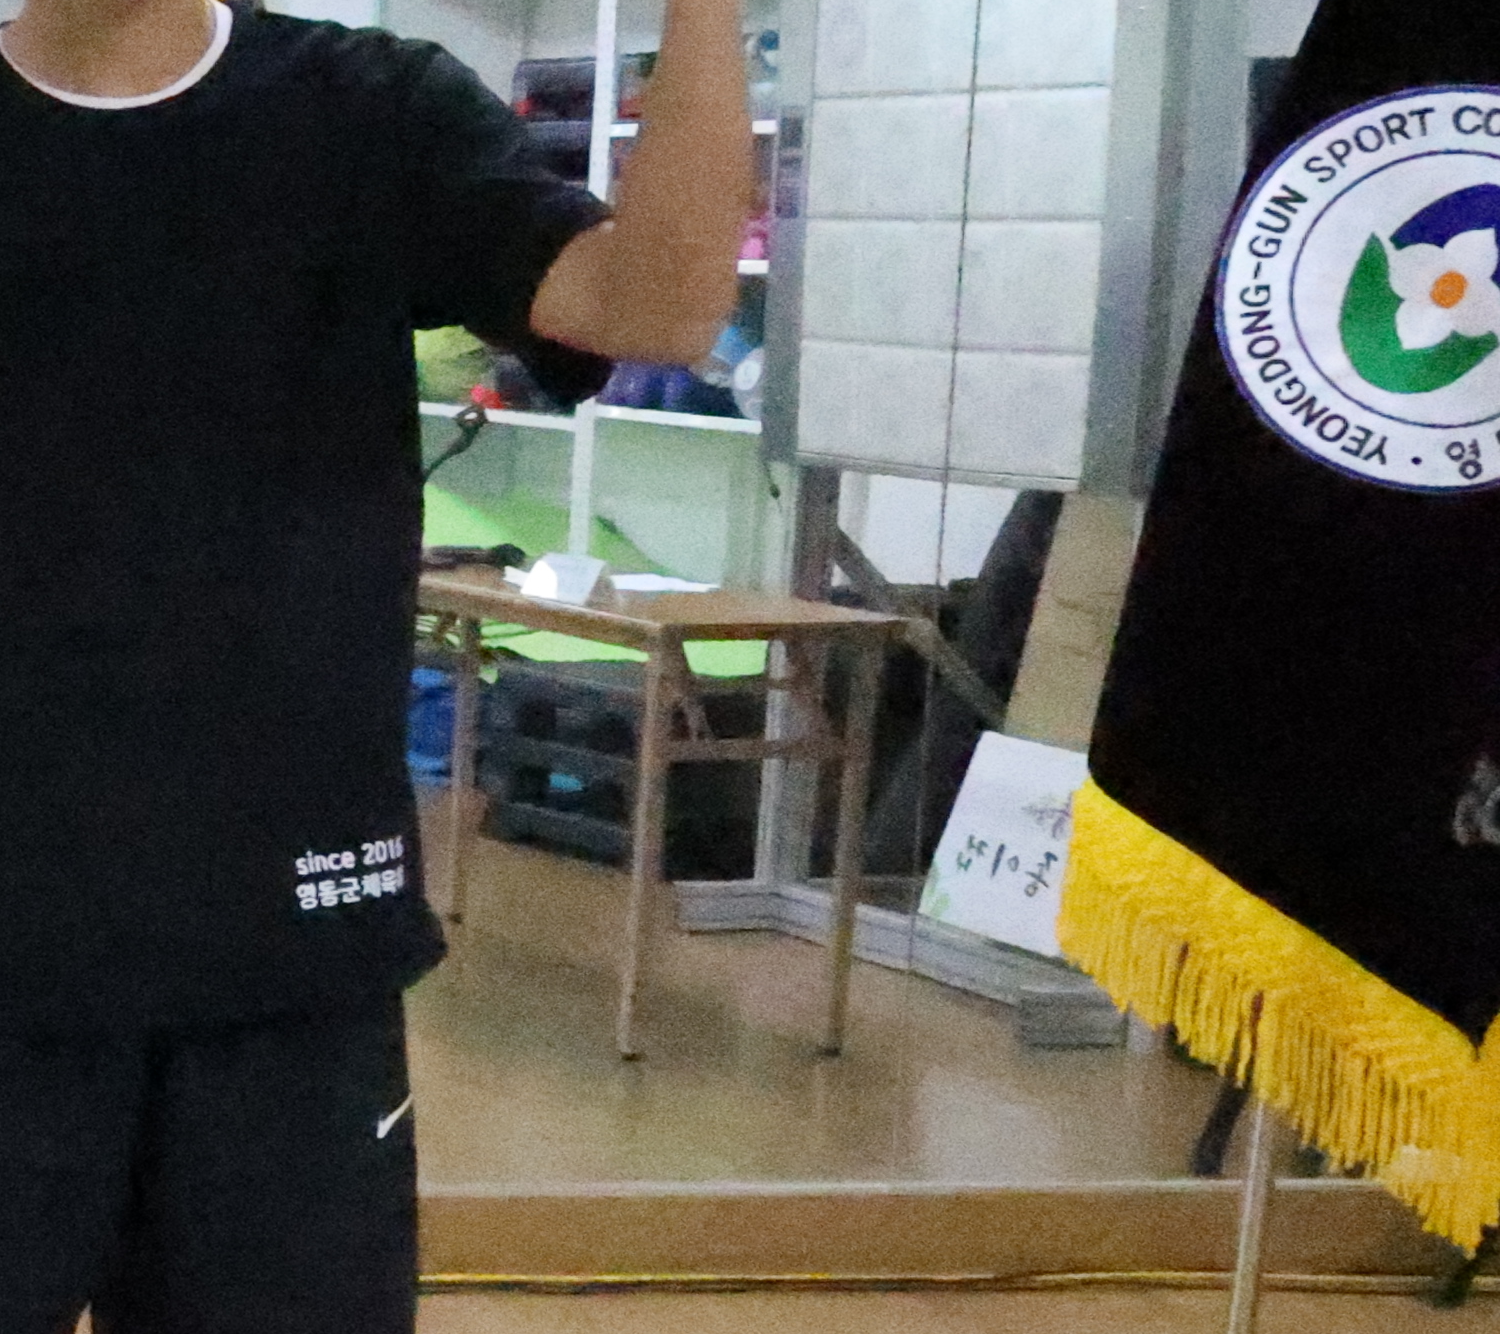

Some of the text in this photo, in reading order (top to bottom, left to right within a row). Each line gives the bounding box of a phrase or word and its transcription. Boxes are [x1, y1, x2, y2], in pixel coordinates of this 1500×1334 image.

[1304, 107, 1436, 183] SPORT
[1240, 185, 1388, 465] YEONGDONG-GUN
[295, 850, 356, 875] since
